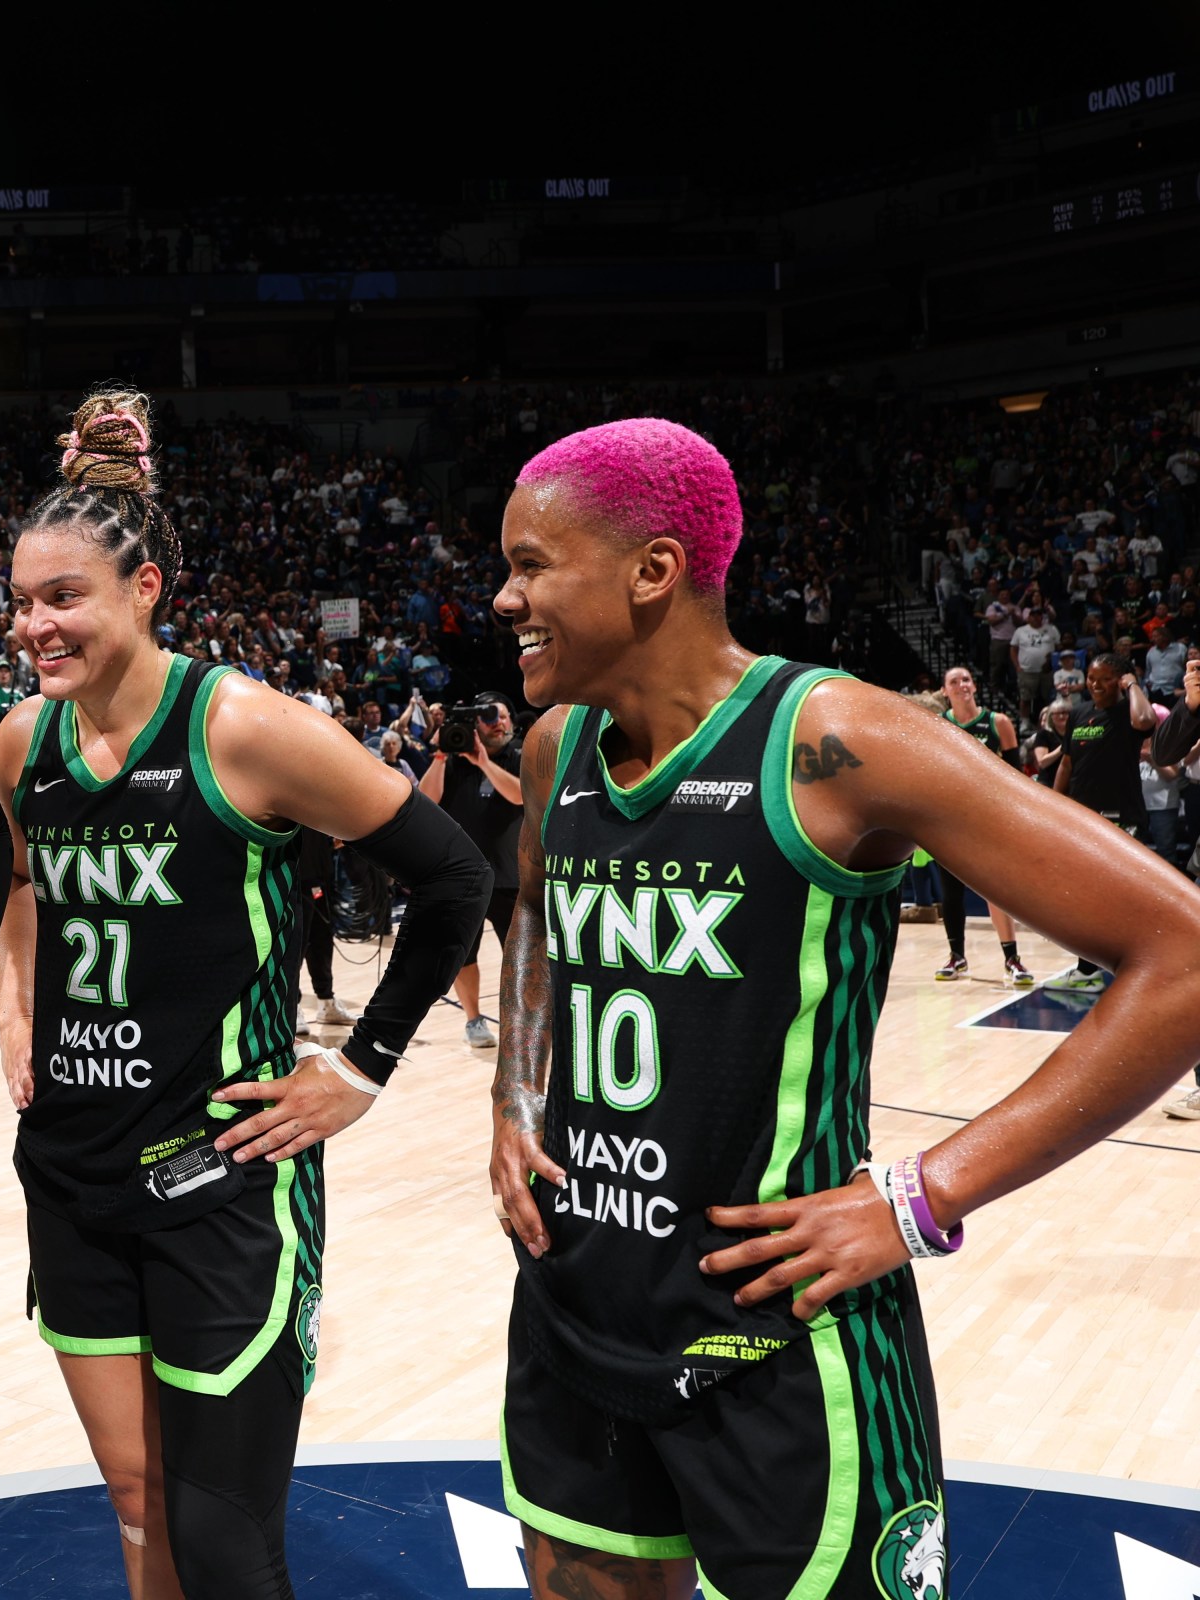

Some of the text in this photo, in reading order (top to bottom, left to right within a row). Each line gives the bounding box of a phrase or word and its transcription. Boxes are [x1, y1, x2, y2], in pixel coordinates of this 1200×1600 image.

[1145, 72, 1176, 99] OUT
[26, 188, 48, 208] OUT
[587, 178, 610, 198] OUT
[1081, 326, 1107, 342] 120
[130, 769, 182, 781] FEDERATED
[675, 781, 754, 796] FEDERATED
[28, 822, 178, 842] MINNESOTA
[27, 842, 183, 906] LYNX
[545, 857, 746, 887] MINNESOTA
[544, 880, 745, 979] LYNX
[61, 917, 131, 1007] 21
[60, 1017, 142, 1051] MAYO
[570, 984, 661, 1112] 10
[49, 1058, 152, 1088] CLINIC
[159, 1146, 180, 1161] REBEL
[567, 1126, 668, 1182] MAYO
[553, 1182, 680, 1237] CLINIC
[705, 1344, 739, 1359] REBEL
[740, 1347, 771, 1361] EDIT
